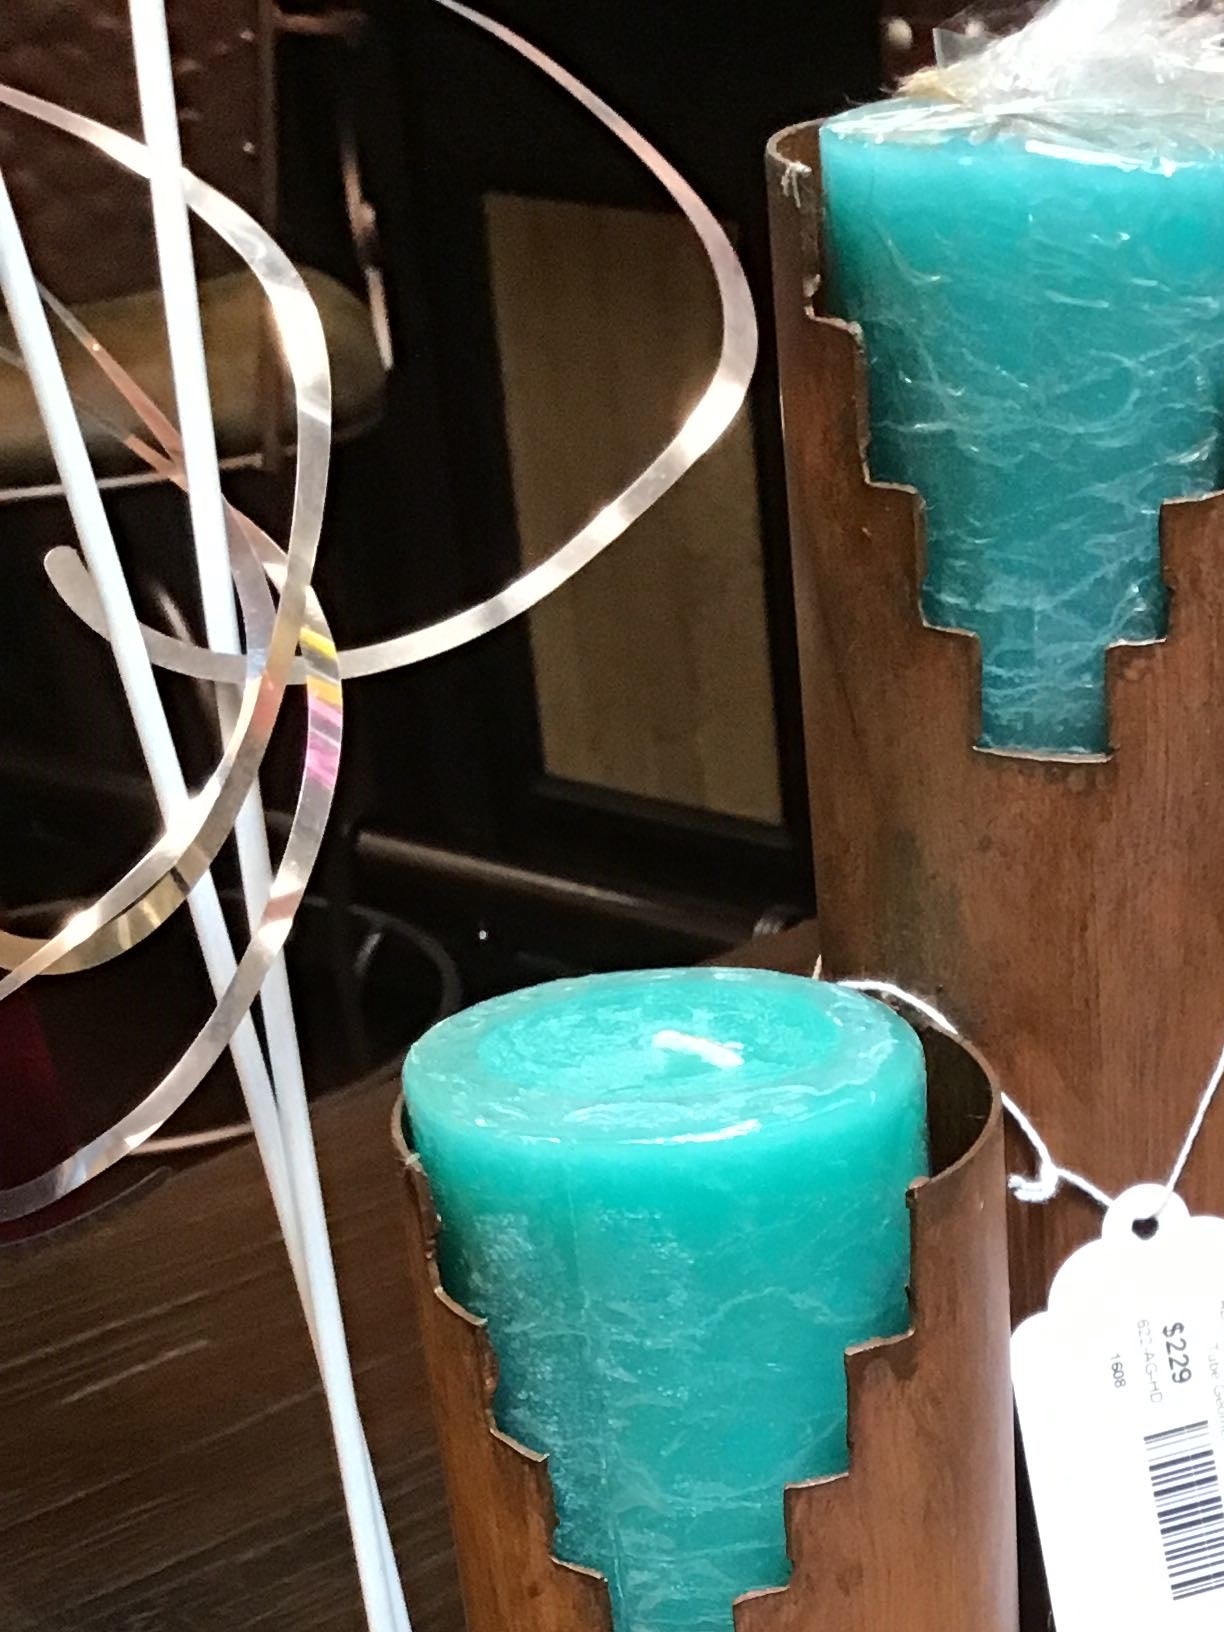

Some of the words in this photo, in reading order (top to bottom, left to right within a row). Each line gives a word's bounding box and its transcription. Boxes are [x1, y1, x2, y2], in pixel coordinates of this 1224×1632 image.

[1111, 1353, 1127, 1389] 1608
[1162, 1321, 1192, 1384] $229
[1208, 1342, 1221, 1380] Tube
